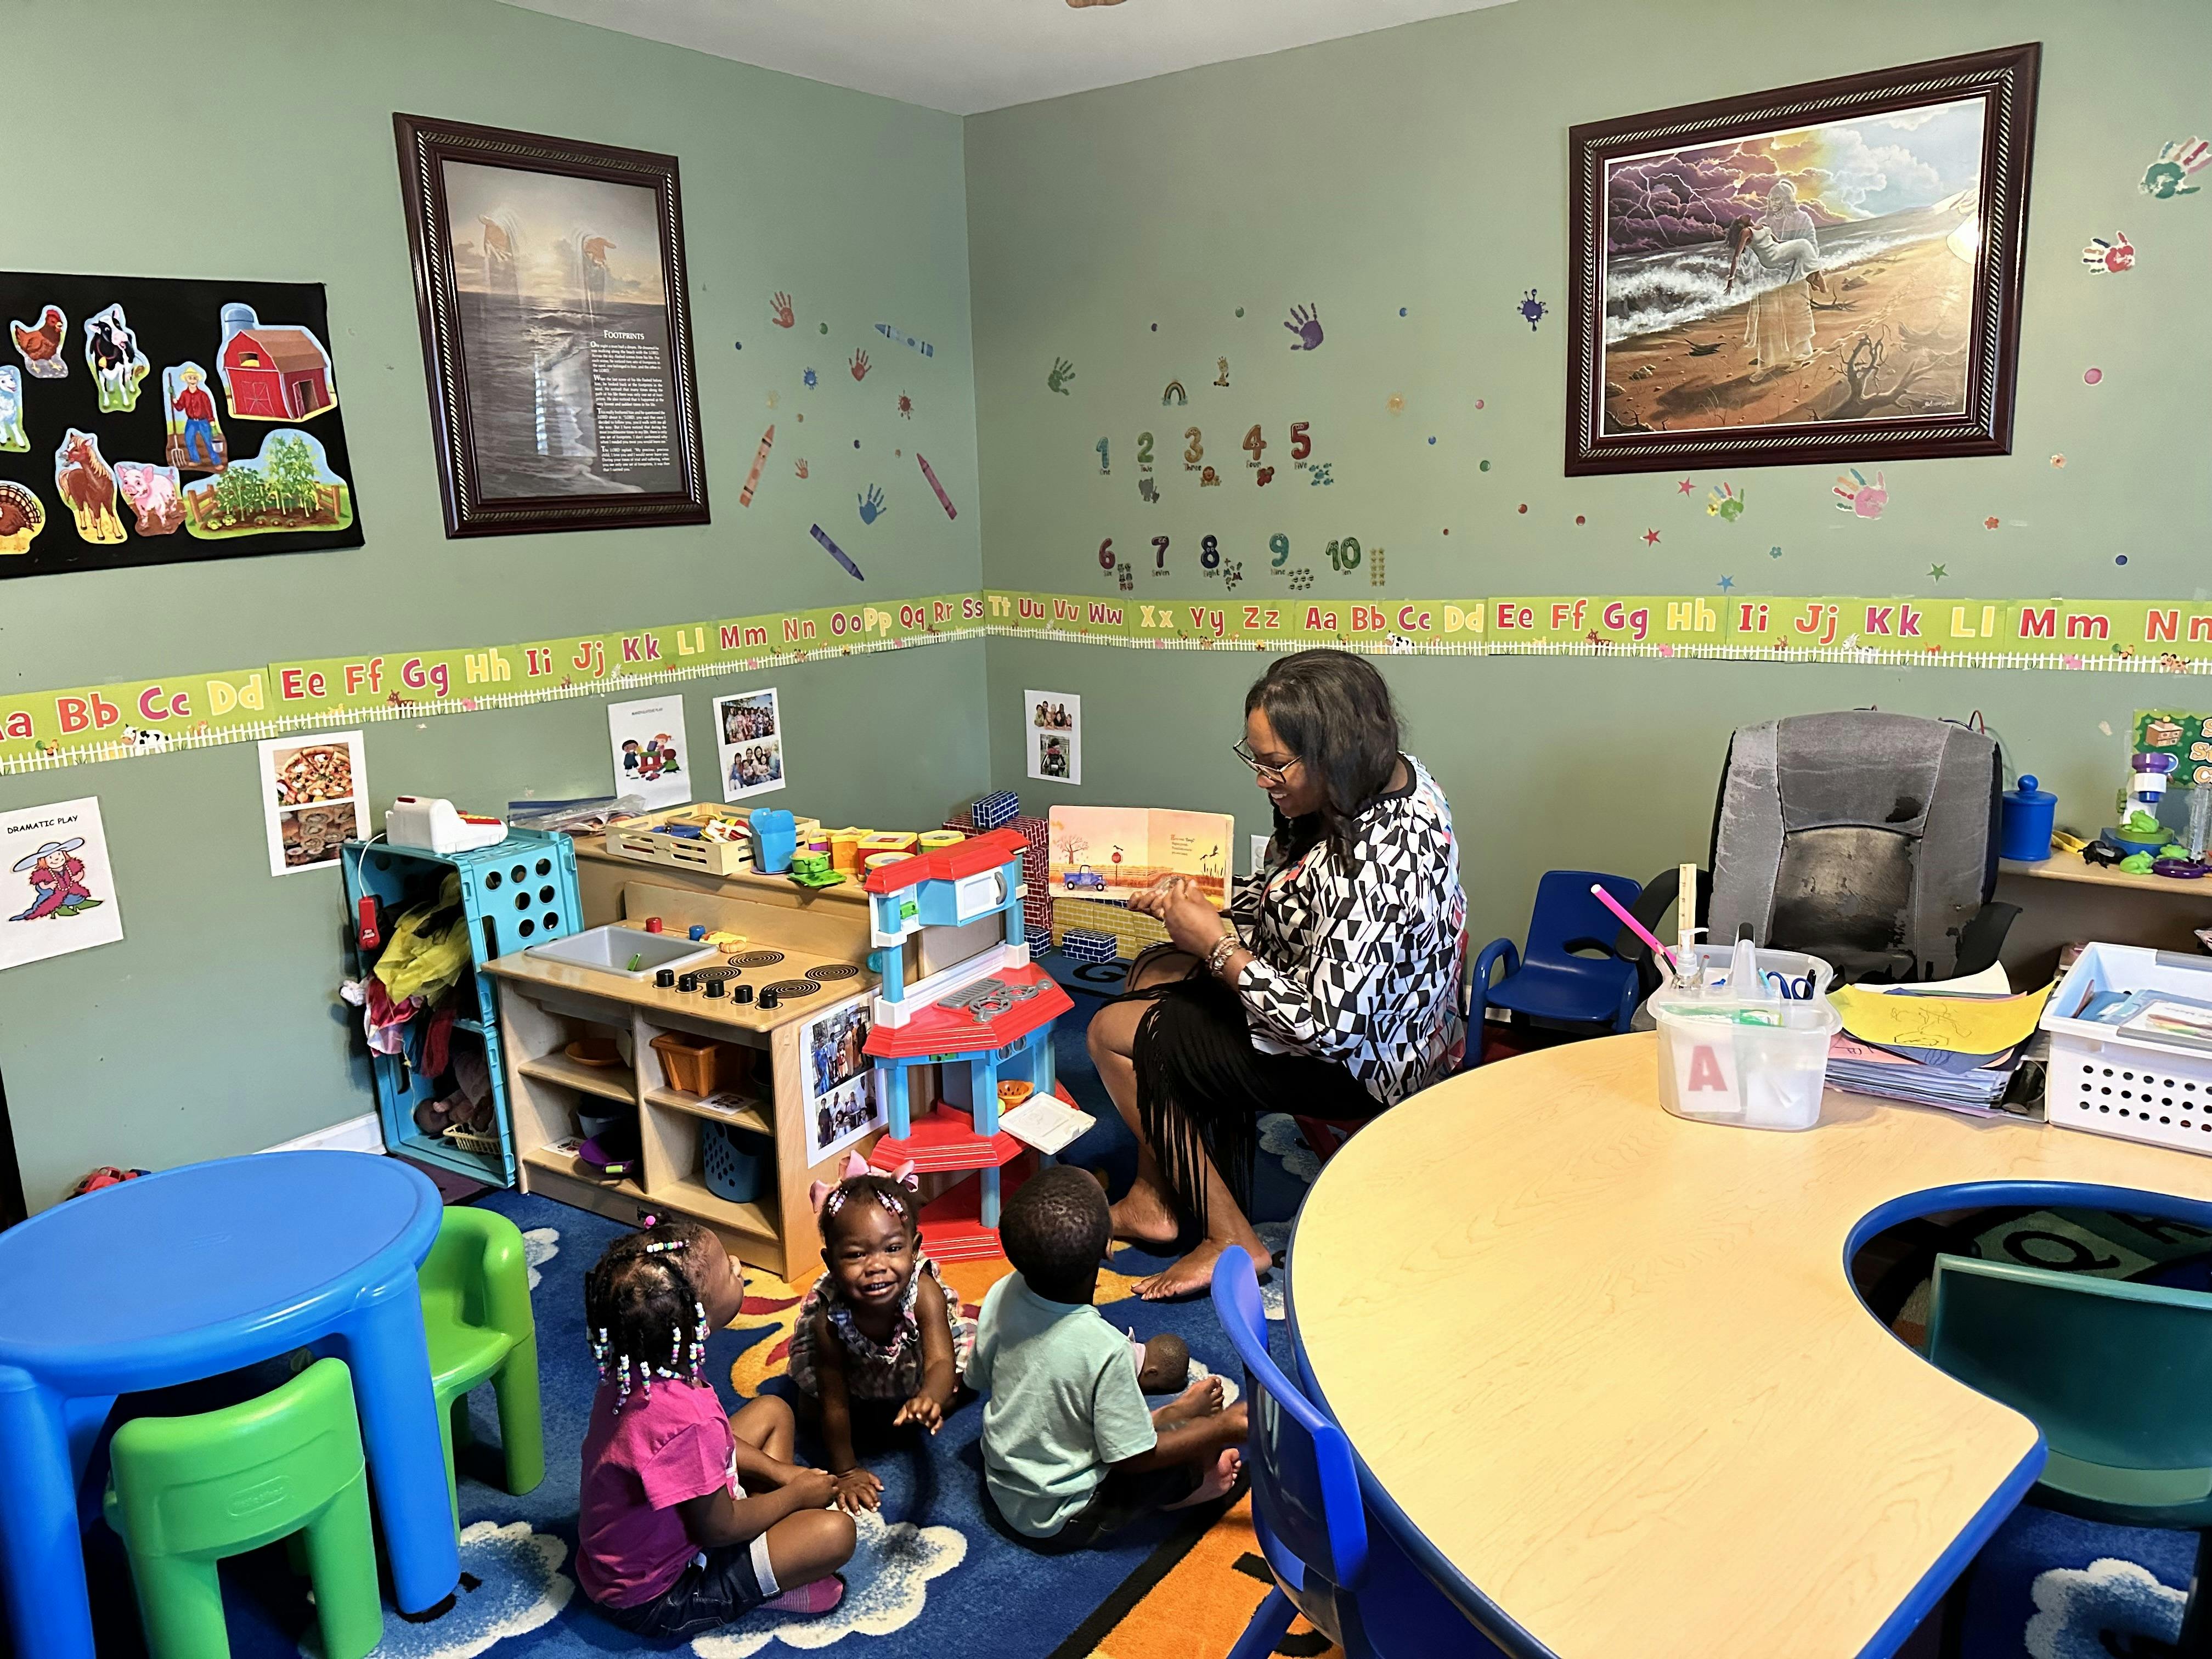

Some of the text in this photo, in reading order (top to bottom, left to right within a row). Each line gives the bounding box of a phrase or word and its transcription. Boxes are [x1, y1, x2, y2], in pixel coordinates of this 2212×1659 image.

[603, 330, 645, 340] FOOTPRINTS
[1096, 436, 1110, 469] 1
[1137, 432, 1154, 463] 2
[1184, 426, 1204, 463] 3
[1243, 424, 1267, 461] 4
[1291, 421, 1311, 460] 5
[1099, 468, 1111, 476] One
[1183, 462, 1201, 471] Three
[1246, 460, 1261, 469] Four
[1098, 538, 1116, 569] 6
[1152, 535, 1169, 568] 7
[1200, 534, 1220, 569] 8
[1269, 532, 1289, 567] 9
[1325, 536, 1361, 571] 10
[1203, 569, 1220, 578] Eight
[988, 595, 1280, 637] Tt Uu Vv Ww Xx Yy Zz
[1305, 597, 2212, 645] Aa Bb Cc Dd Ee Ff Gg Hh Ii Jj Kk Ll Mm Nn
[0, 597, 984, 741] a Bb Cc Dd Ee Ff Gg Hh Ii Jj Kk Ll Mm Nn Oo Pp Qq Rr Ss
[8, 815, 78, 834] DRAMATIC PLAY
[1688, 1045, 1728, 1091] A
